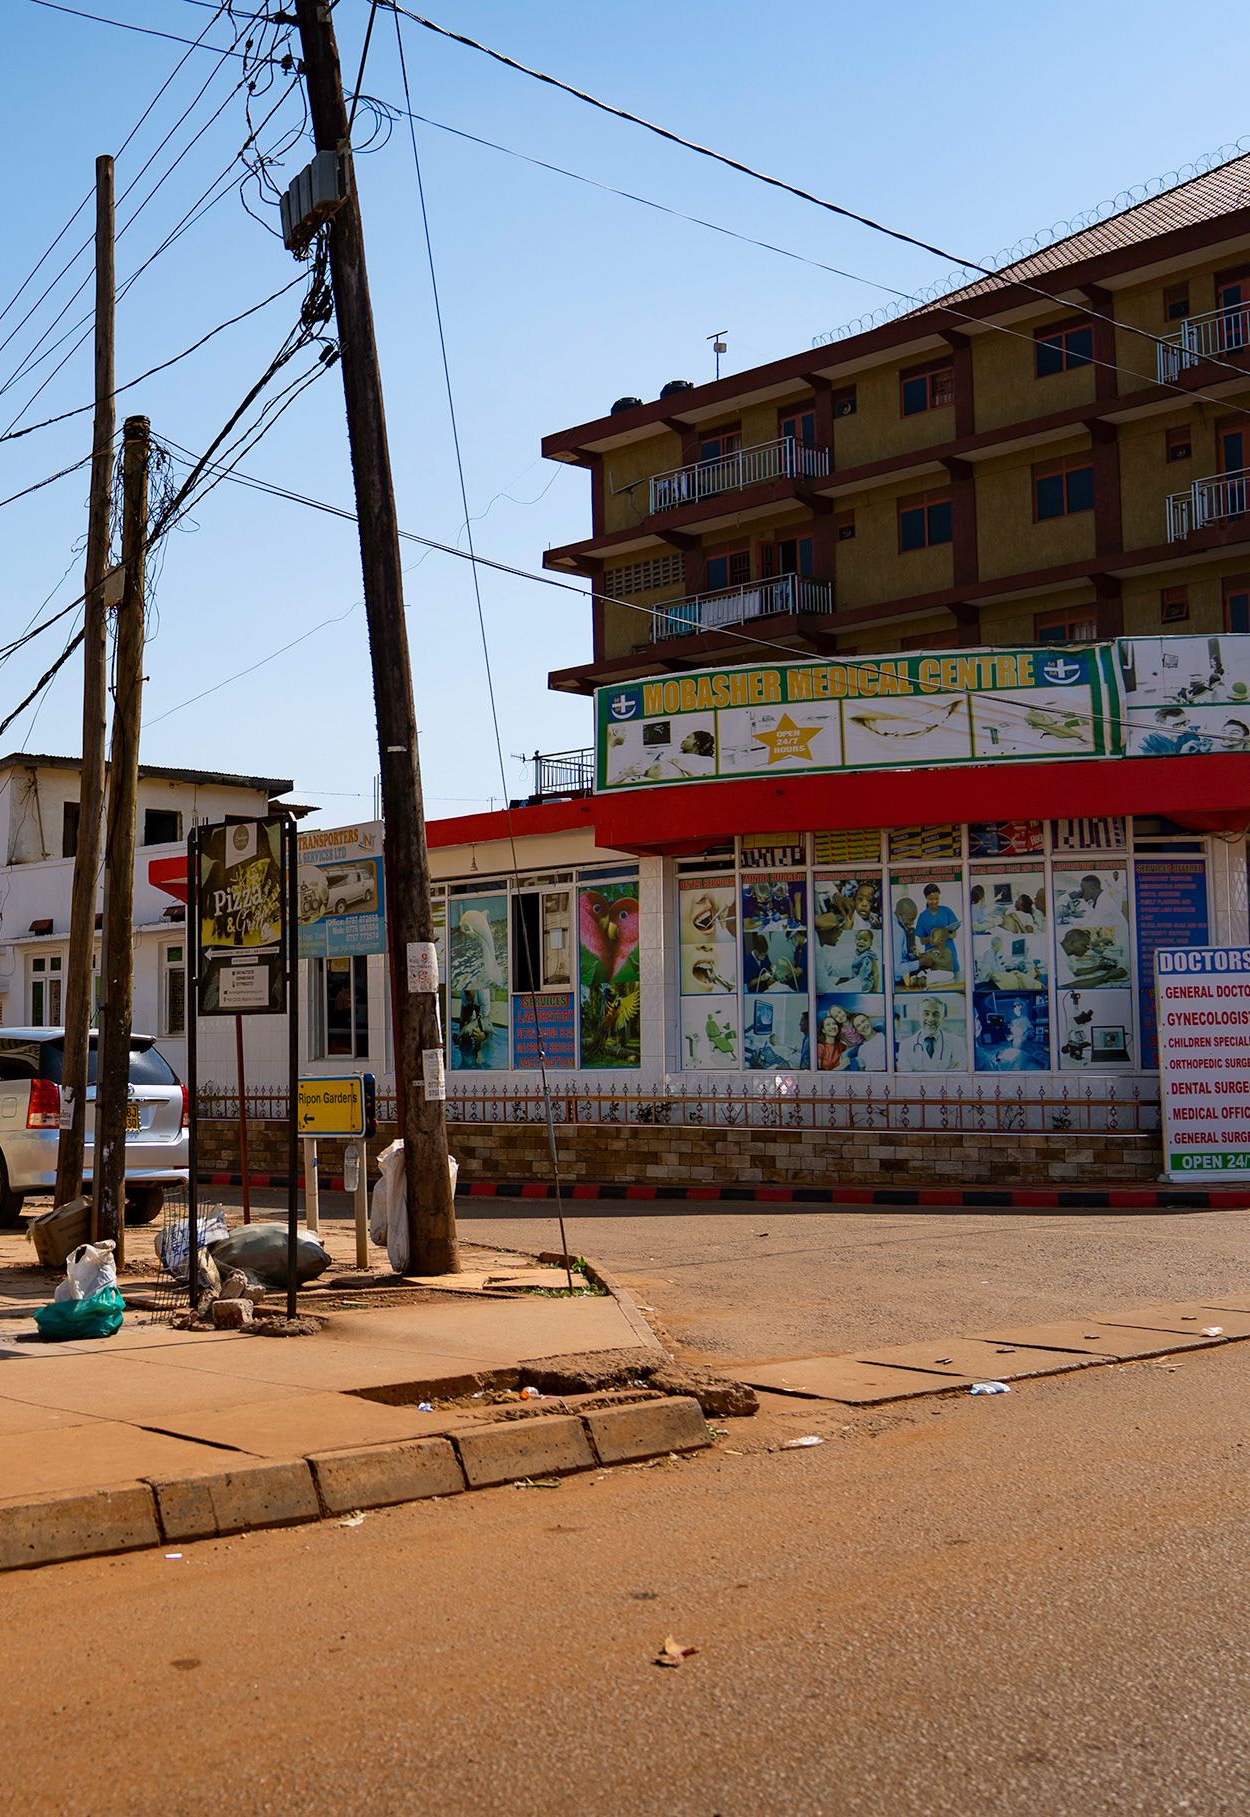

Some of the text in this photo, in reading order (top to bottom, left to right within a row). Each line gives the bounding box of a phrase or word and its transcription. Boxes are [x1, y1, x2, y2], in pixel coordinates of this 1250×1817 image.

[643, 654, 1035, 716] MOBASHER MEDICAL CENTRE
[774, 745, 806, 754] HOURS
[298, 829, 359, 850] TRANSPORTERS
[303, 847, 347, 863] SERVICES LTD
[213, 886, 262, 916] Pizza
[227, 917, 236, 933] &
[1165, 986, 1214, 999] GENERAL
[524, 996, 567, 1006] SERVICES
[1168, 1037, 1212, 1048] CHILDREN
[1170, 1058, 1223, 1069] ORTHOPEDIC
[1171, 1081, 1250, 1095] DENTAL SURGE
[298, 1092, 357, 1106] Ripon Gardens
[1173, 1107, 1218, 1120] MEDICAL
[1174, 1132, 1218, 1144] GENERAL
[1182, 1155, 1223, 1169] OPEN
